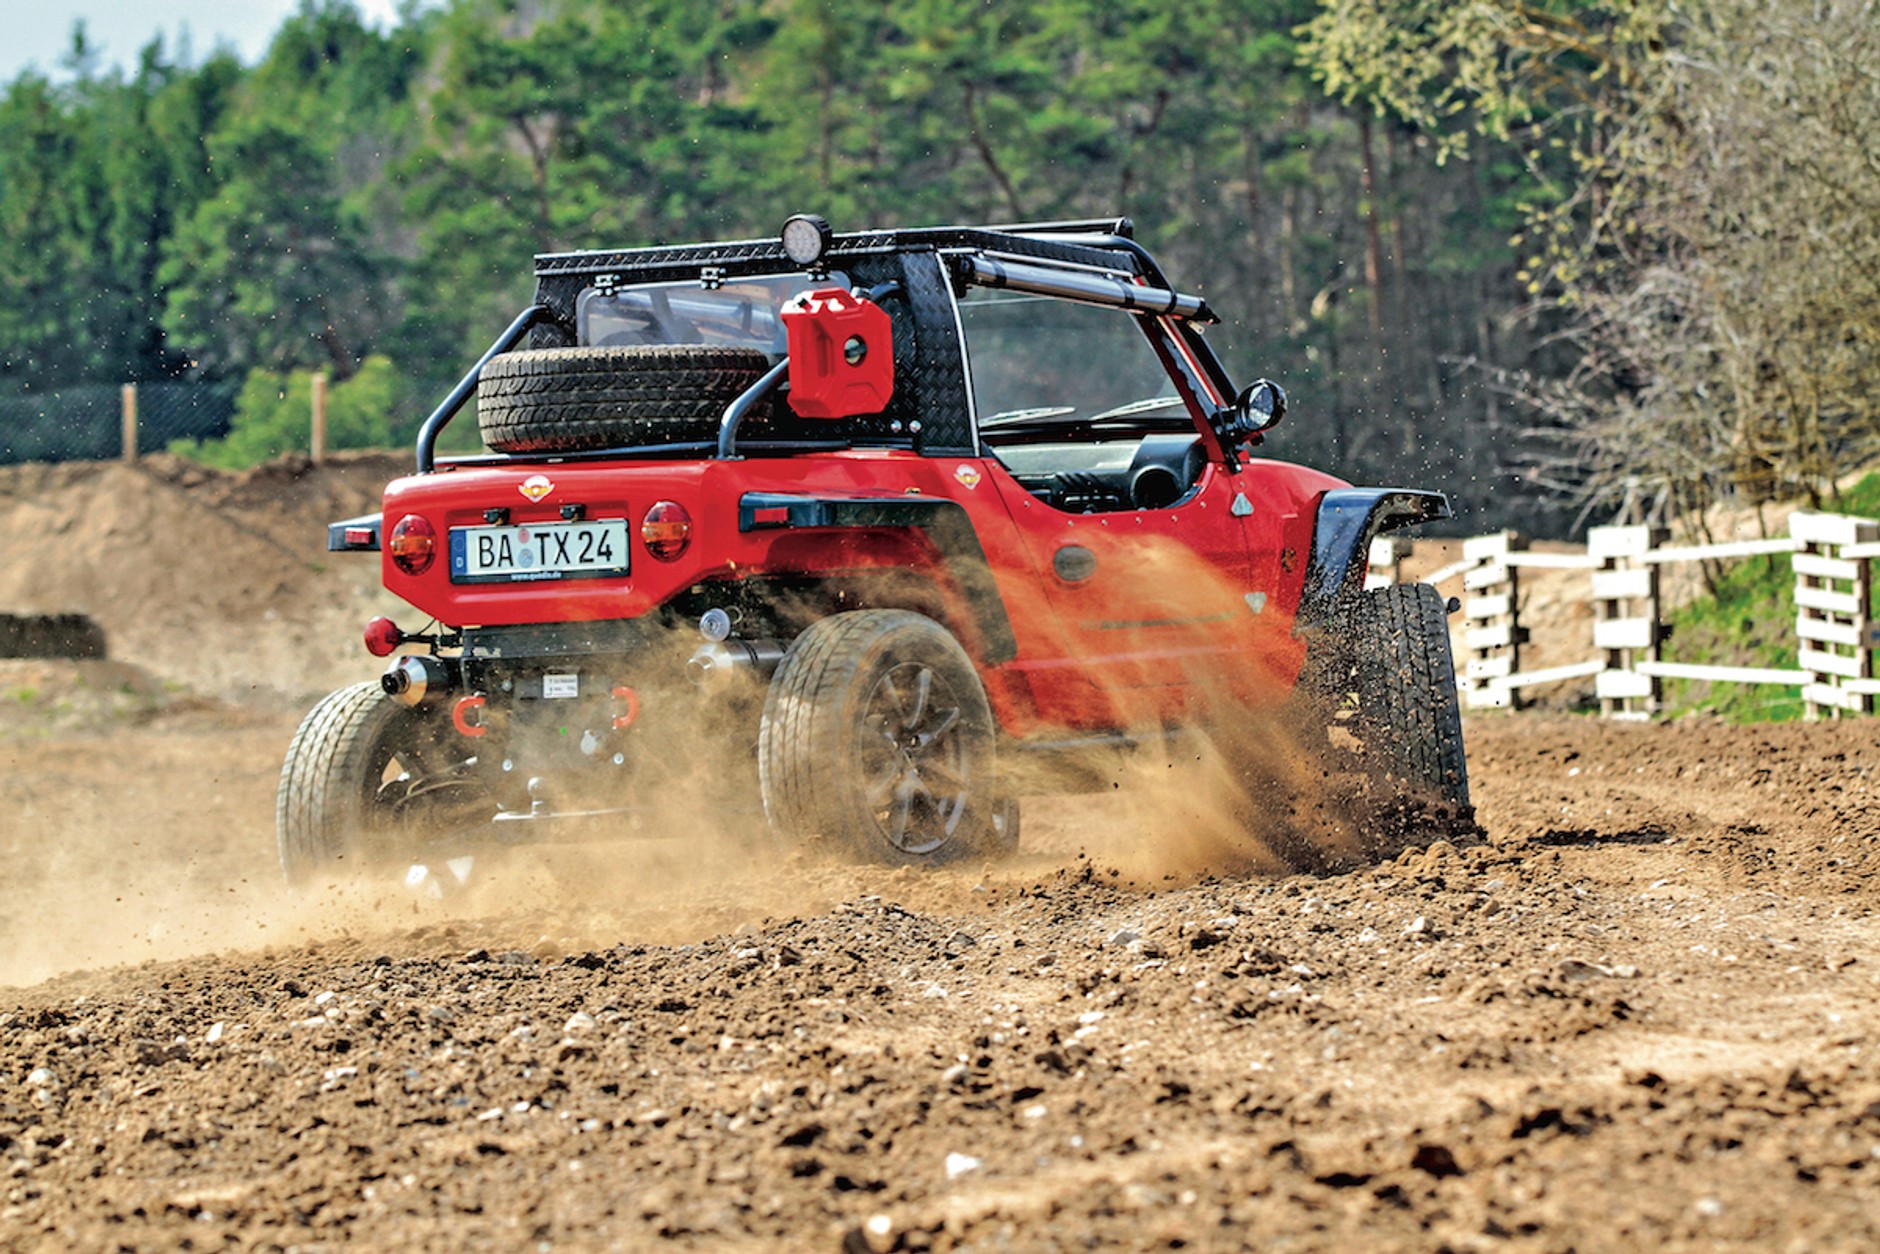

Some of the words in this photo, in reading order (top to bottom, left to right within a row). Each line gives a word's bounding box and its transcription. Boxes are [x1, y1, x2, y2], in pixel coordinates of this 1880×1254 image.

[479, 535, 514, 568] BA
[534, 531, 571, 566] TX
[578, 529, 613, 563] 24
[456, 557, 464, 568] D
